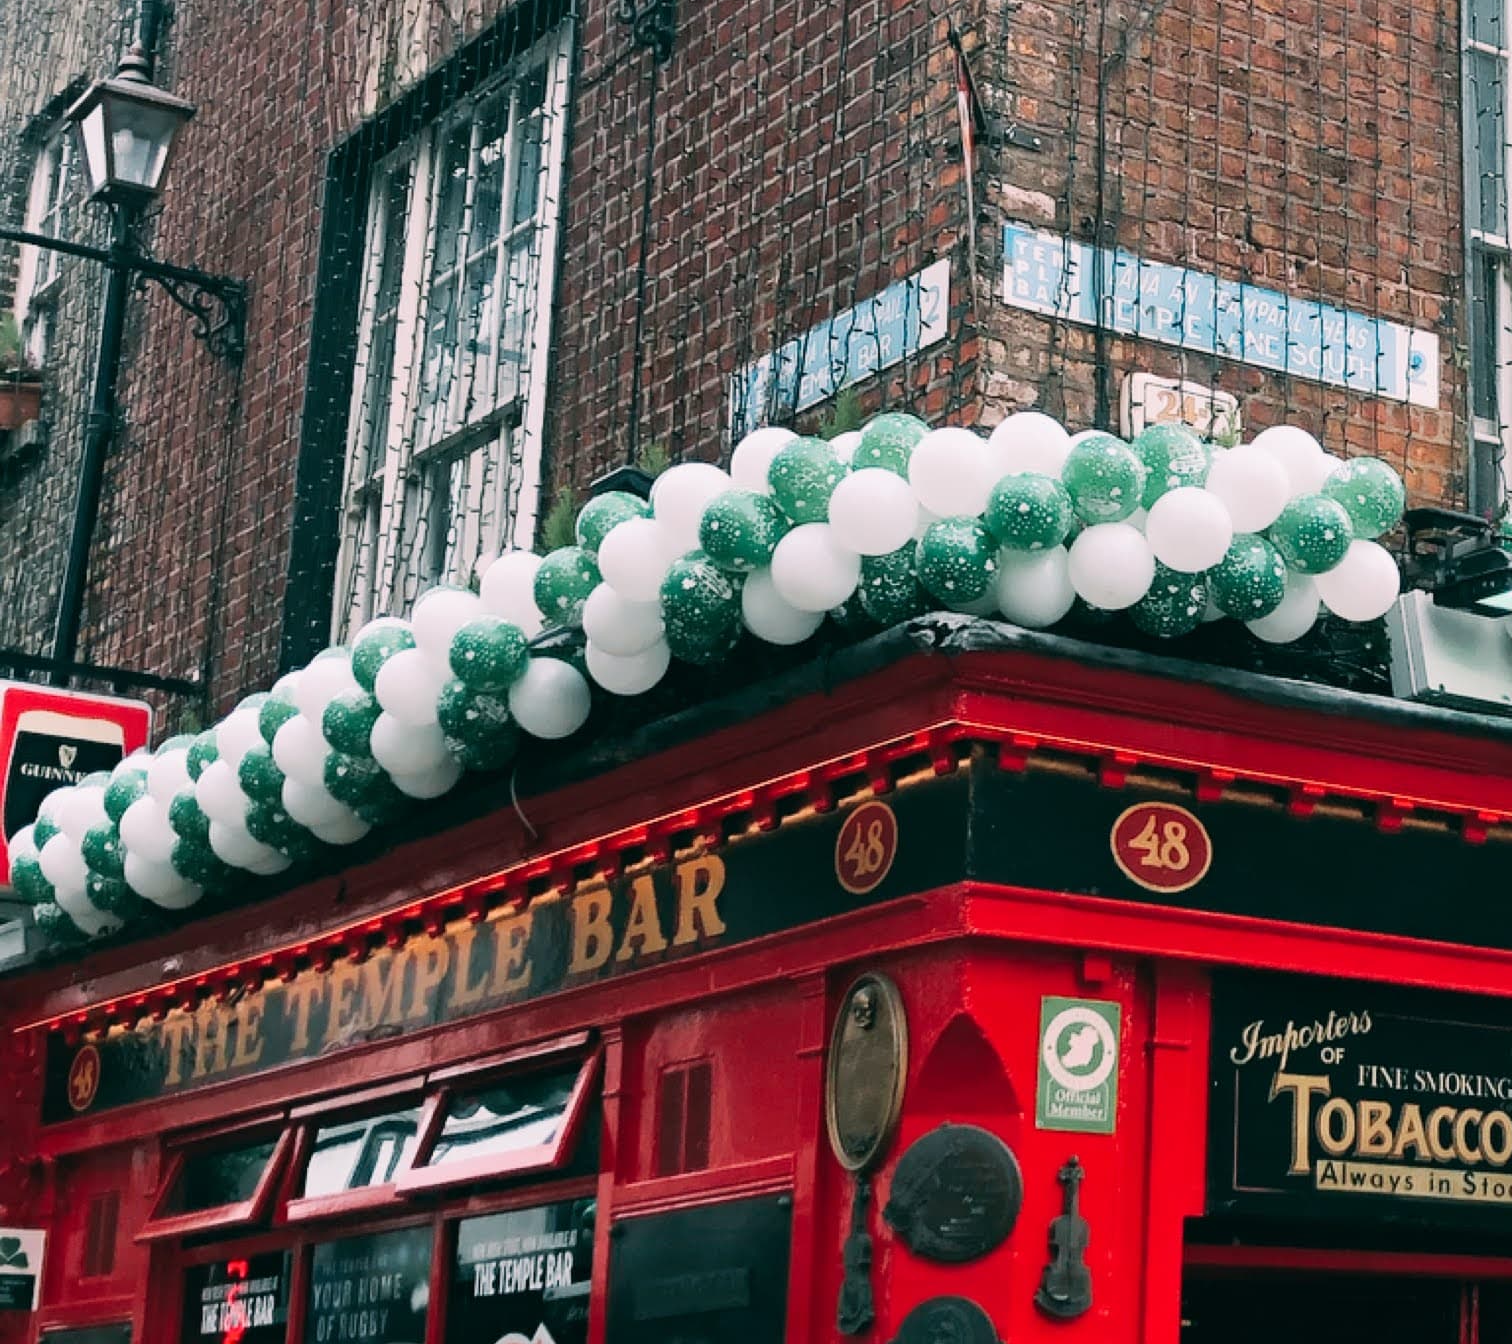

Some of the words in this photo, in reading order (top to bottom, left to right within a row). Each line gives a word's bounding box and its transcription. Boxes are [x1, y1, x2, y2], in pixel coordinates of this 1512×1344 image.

[840, 816, 886, 878] 48
[1127, 813, 1191, 871] 48
[160, 994, 266, 1087] THE
[282, 912, 534, 1052] TEMPLE
[567, 852, 728, 977] BAR
[1229, 1009, 1373, 1073] Importers
[1320, 1046, 1346, 1065] OF
[1356, 1063, 1410, 1091] FINE
[1049, 1102, 1104, 1120] Member
[1055, 1088, 1102, 1105] Official
[1319, 1161, 1414, 1193] Always
[1428, 1171, 1451, 1195] in
[313, 1279, 353, 1311] YOUR
[358, 1272, 403, 1305] HOME
[473, 1262, 496, 1297] THE
[498, 1254, 544, 1295] TEMPLE
[545, 1250, 574, 1289] BAR
[316, 1314, 336, 1343] OF
